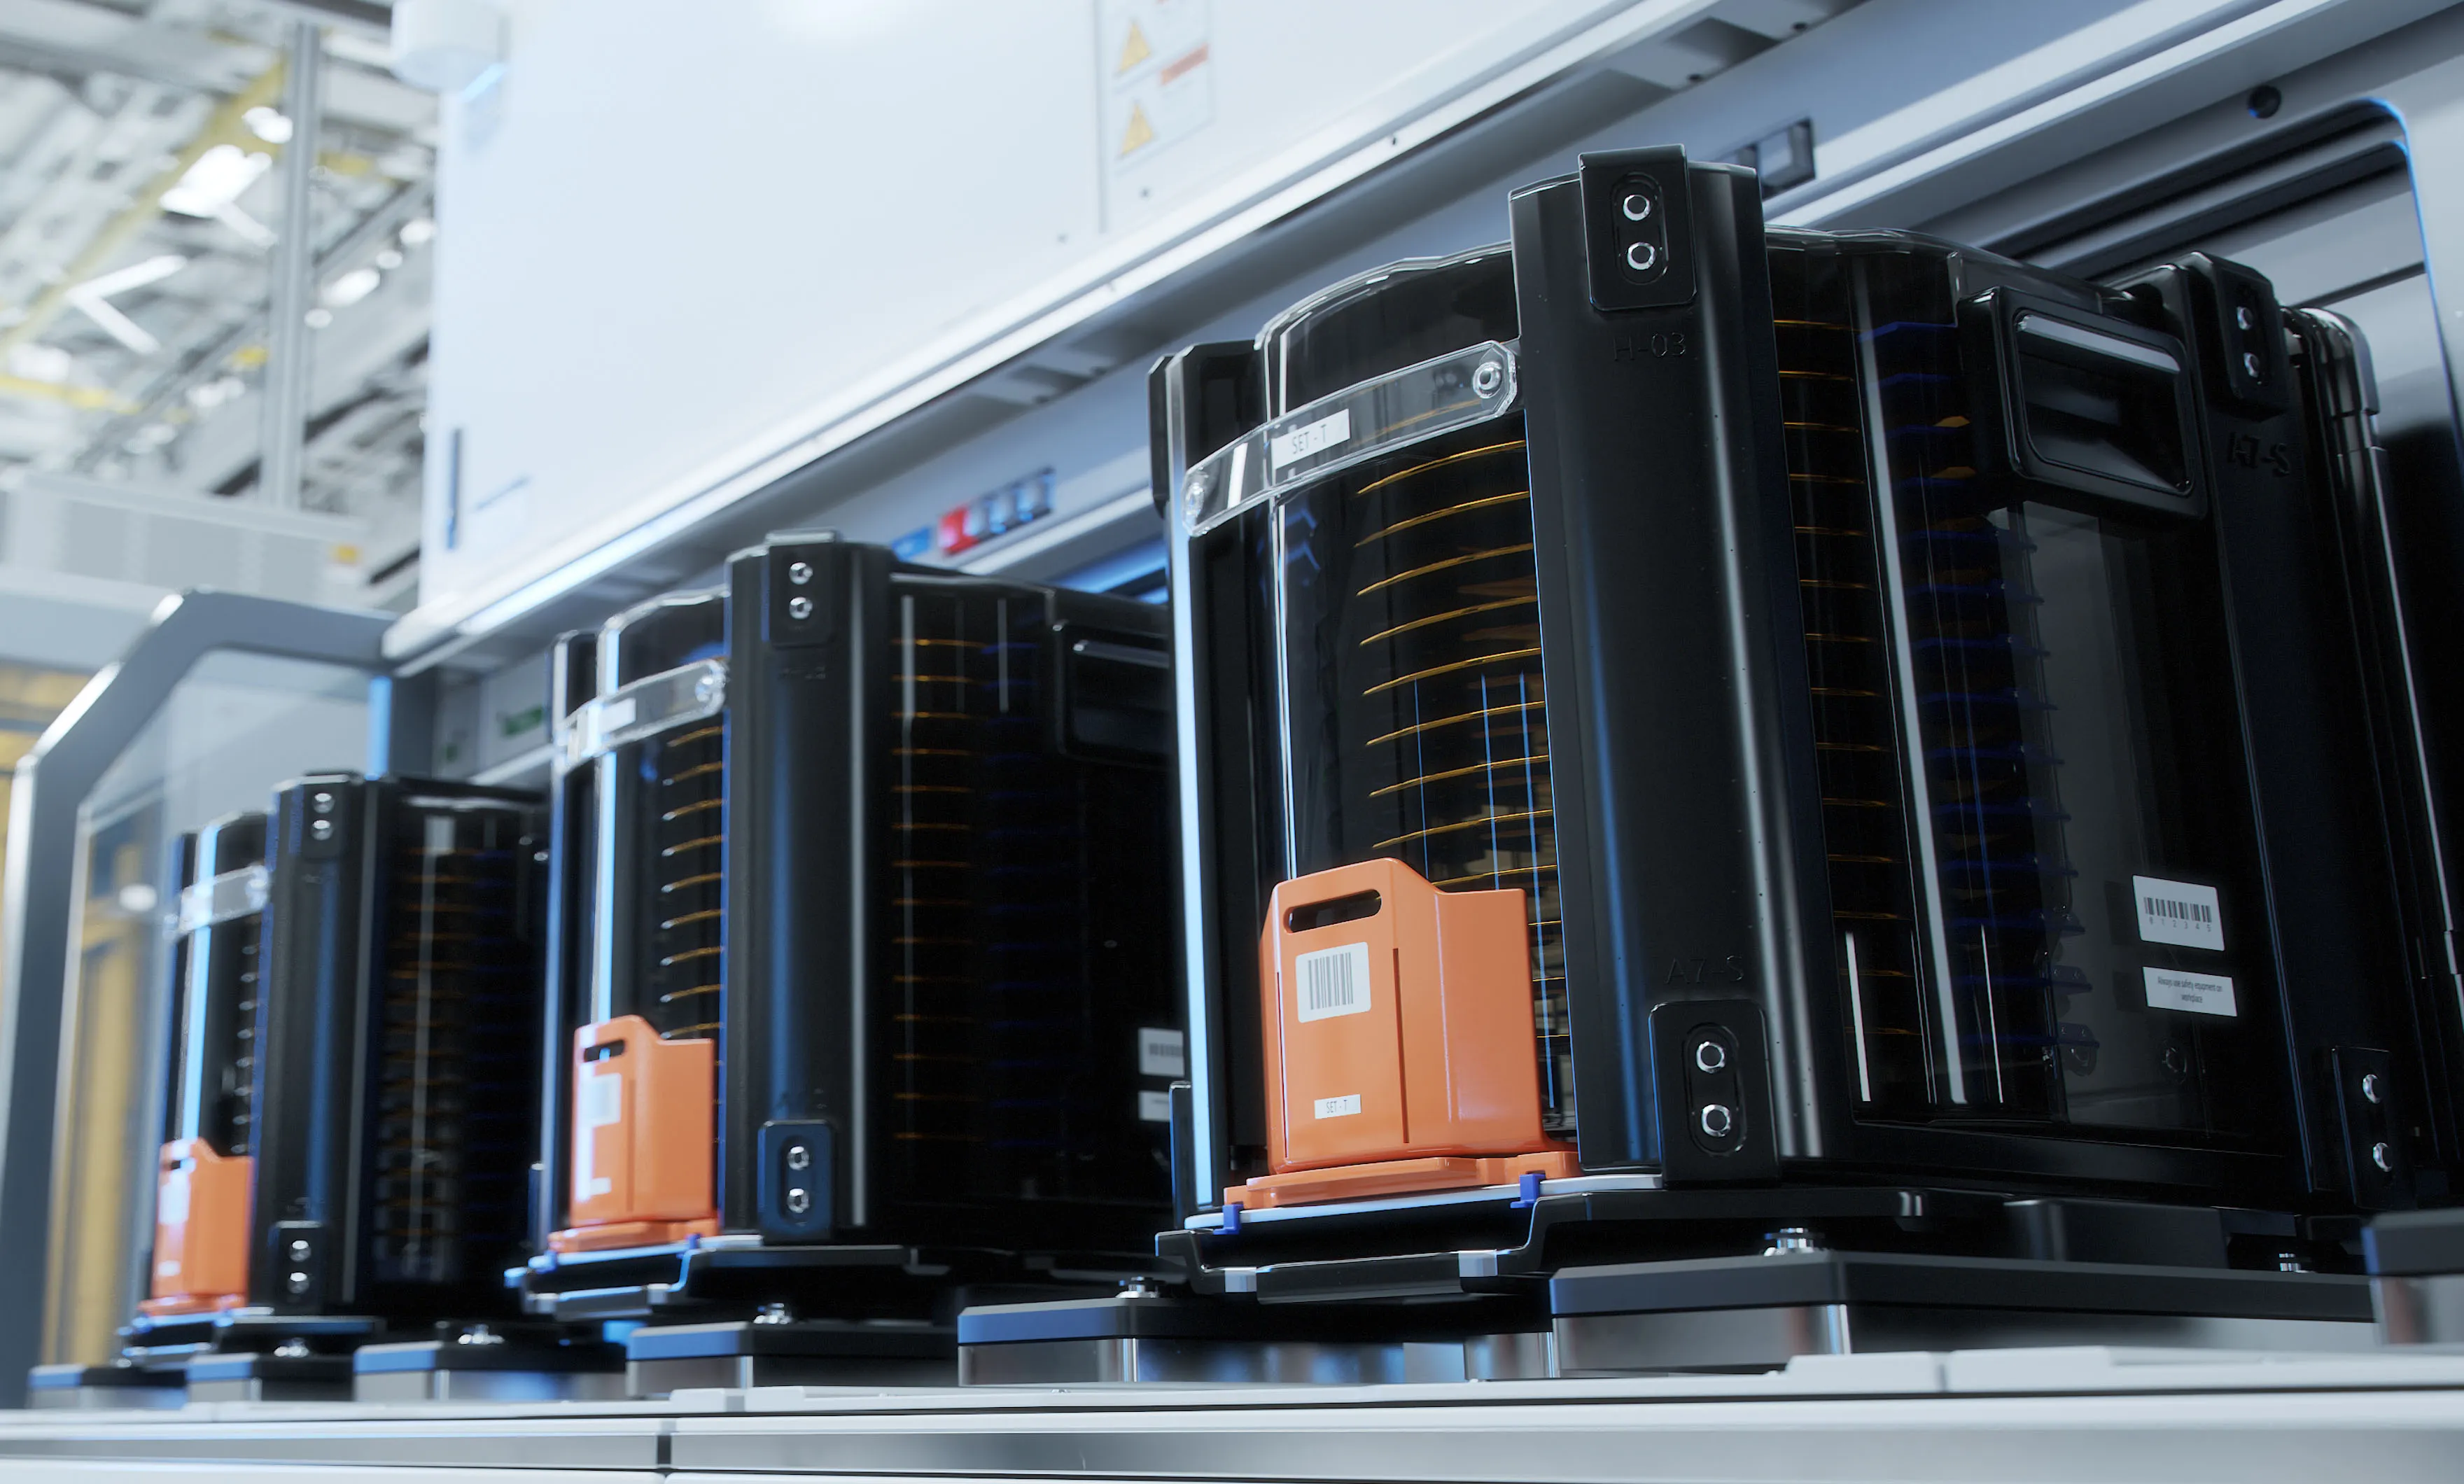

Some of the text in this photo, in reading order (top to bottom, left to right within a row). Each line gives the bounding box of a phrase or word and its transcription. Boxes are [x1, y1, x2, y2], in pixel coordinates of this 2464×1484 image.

[1613, 332, 1686, 361] H-03
[1292, 431, 1309, 454] SET
[1320, 424, 1326, 443] T
[2227, 433, 2290, 477] A7-S
[1664, 955, 1744, 984] A7-S
[2181, 979, 2194, 990] safety
[1326, 1101, 1337, 1113] SET
[1343, 1100, 1347, 1112] T
